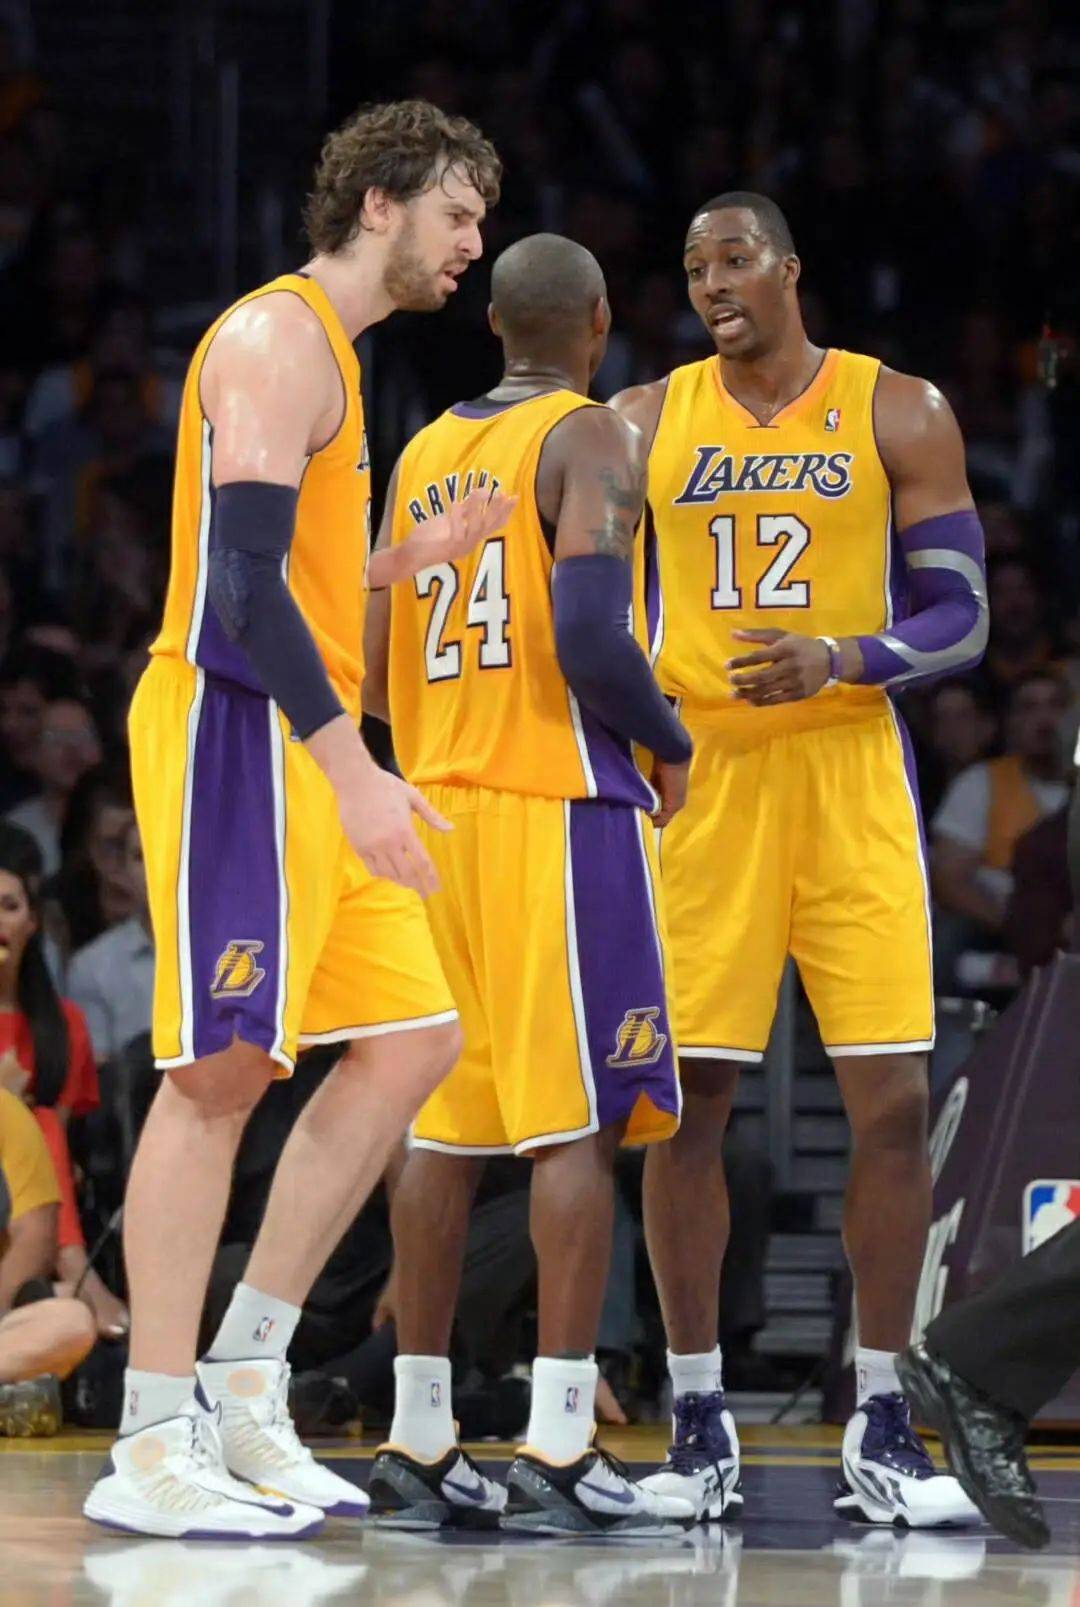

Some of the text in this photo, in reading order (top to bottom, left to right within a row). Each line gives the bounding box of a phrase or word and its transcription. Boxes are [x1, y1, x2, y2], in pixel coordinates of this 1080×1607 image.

[673, 446, 852, 504] LAKERS
[413, 536, 512, 684] 24
[708, 513, 811, 610] 12
